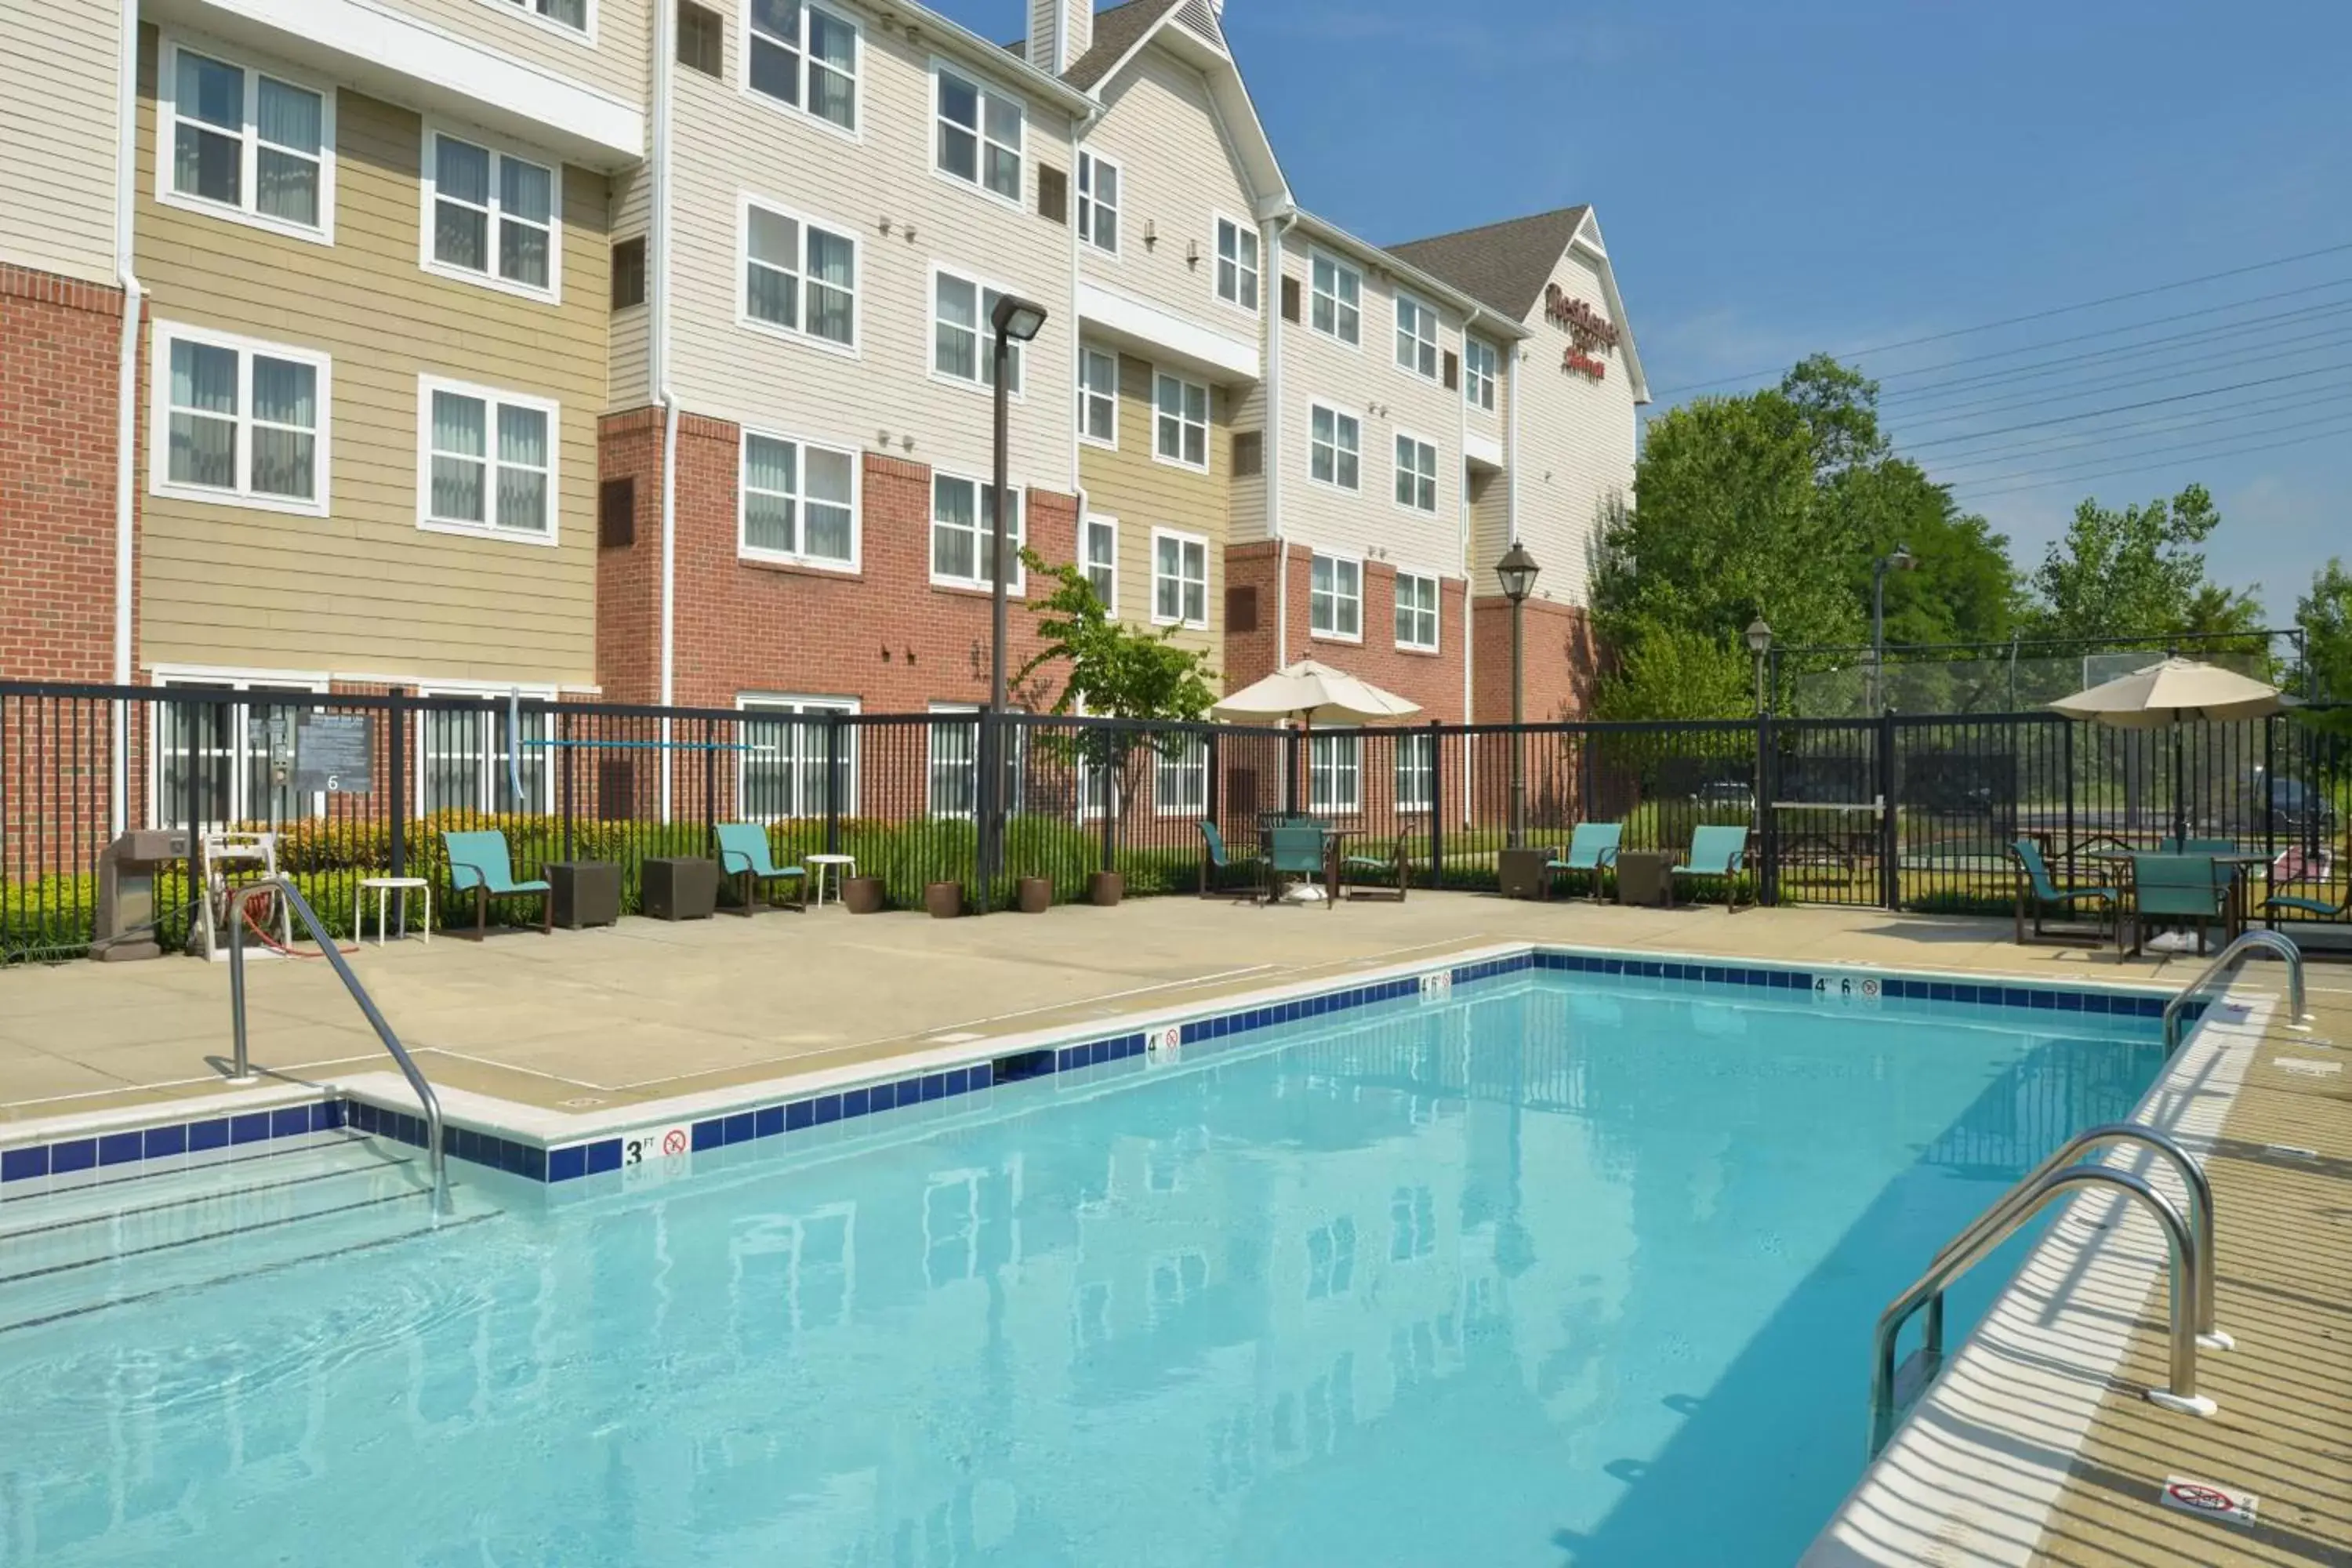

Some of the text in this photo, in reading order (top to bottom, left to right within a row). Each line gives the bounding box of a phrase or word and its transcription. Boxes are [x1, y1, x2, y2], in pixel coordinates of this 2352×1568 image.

[1815, 978, 1826, 991] 4
[1842, 978, 1851, 995] 6
[1148, 1034, 1156, 1051] 4
[626, 1141, 642, 1166] 3
